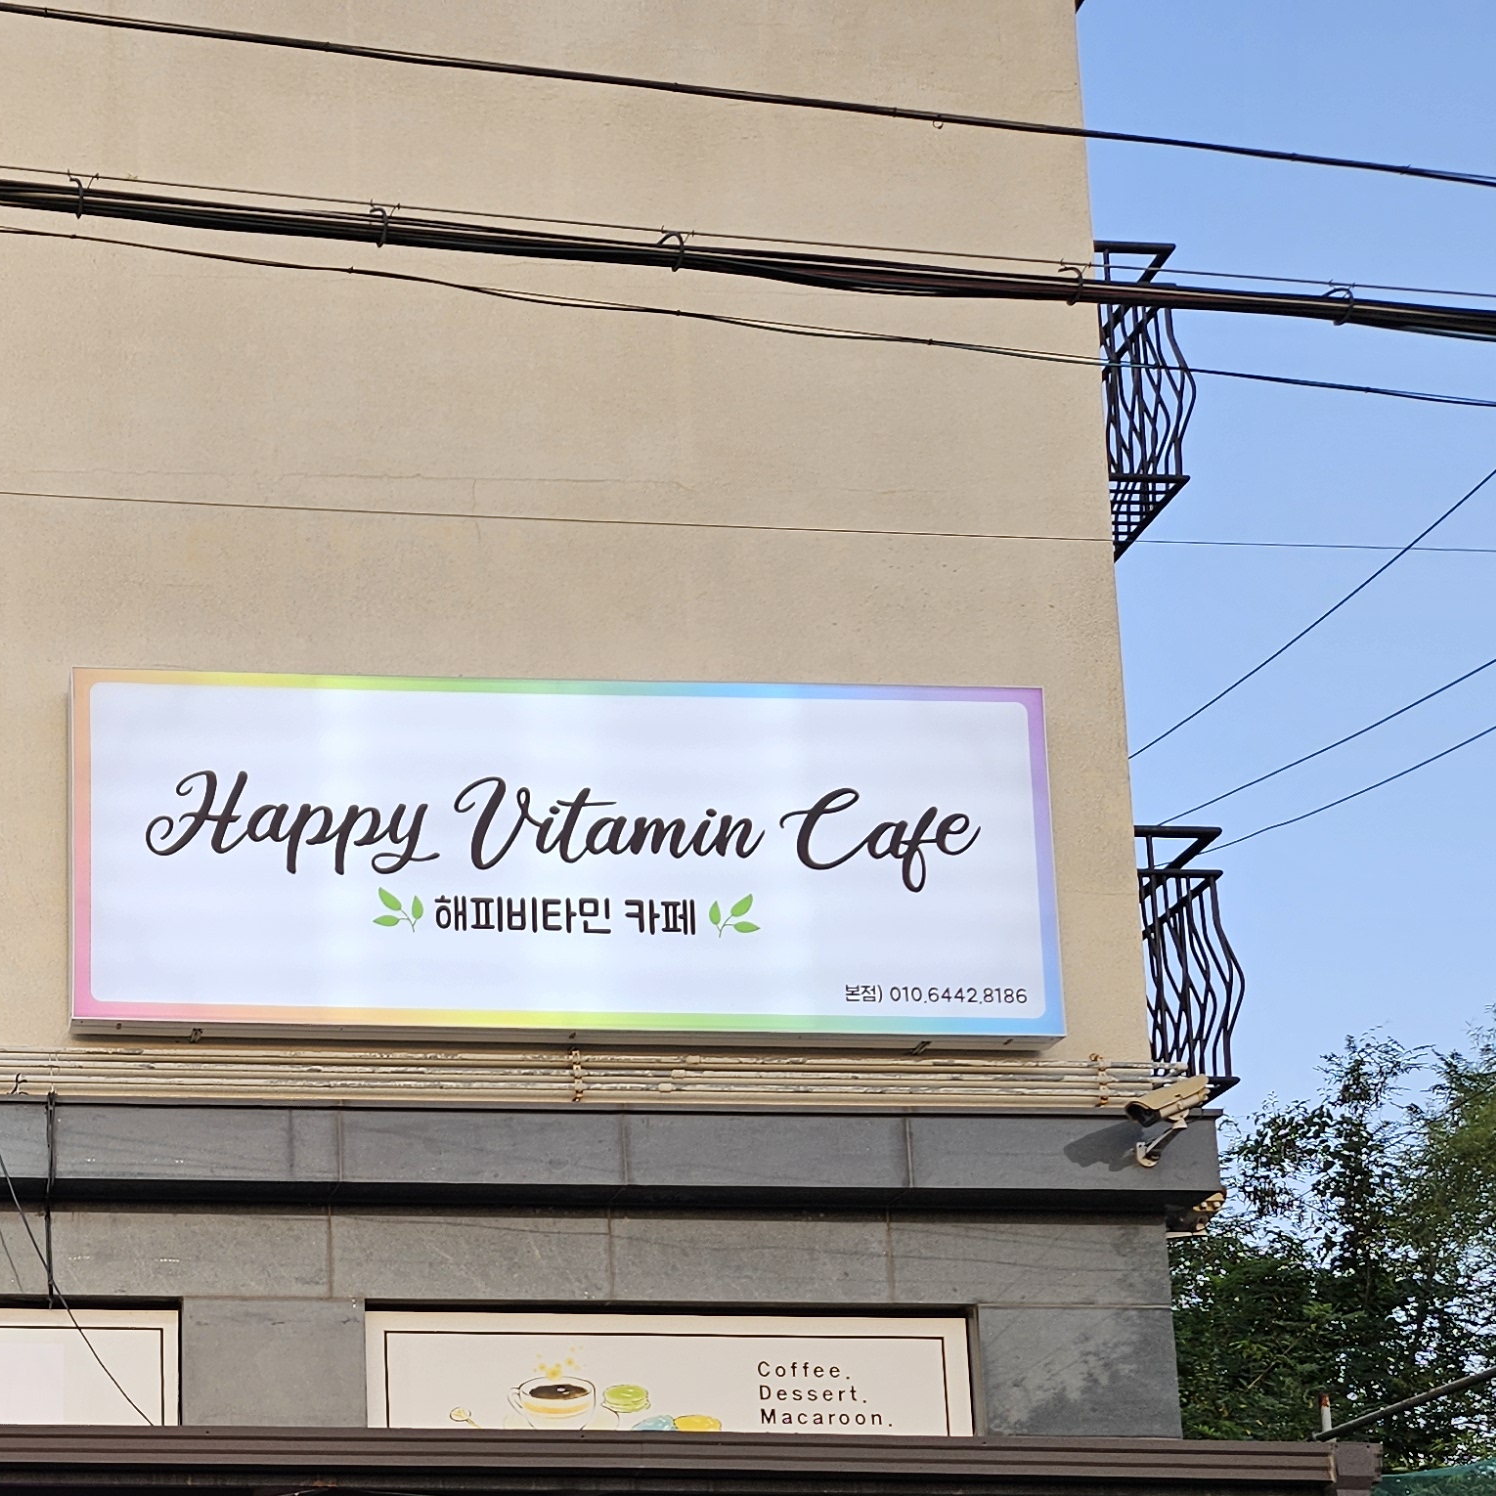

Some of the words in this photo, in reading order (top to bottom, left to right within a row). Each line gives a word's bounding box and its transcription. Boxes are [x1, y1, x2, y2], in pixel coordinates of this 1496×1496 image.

[146, 771, 439, 875] Happy
[454, 777, 765, 870] Vitamin
[780, 788, 981, 892] Cafe
[435, 895, 611, 934] 해피비타민
[625, 900, 695, 935] 카페
[846, 985, 882, 1002] 본점)
[890, 987, 1027, 1003] 010.6442.8186
[758, 1361, 849, 1379] Coffee.
[760, 1385, 866, 1403] Dessert.
[761, 1409, 892, 1427] Macaroon.
